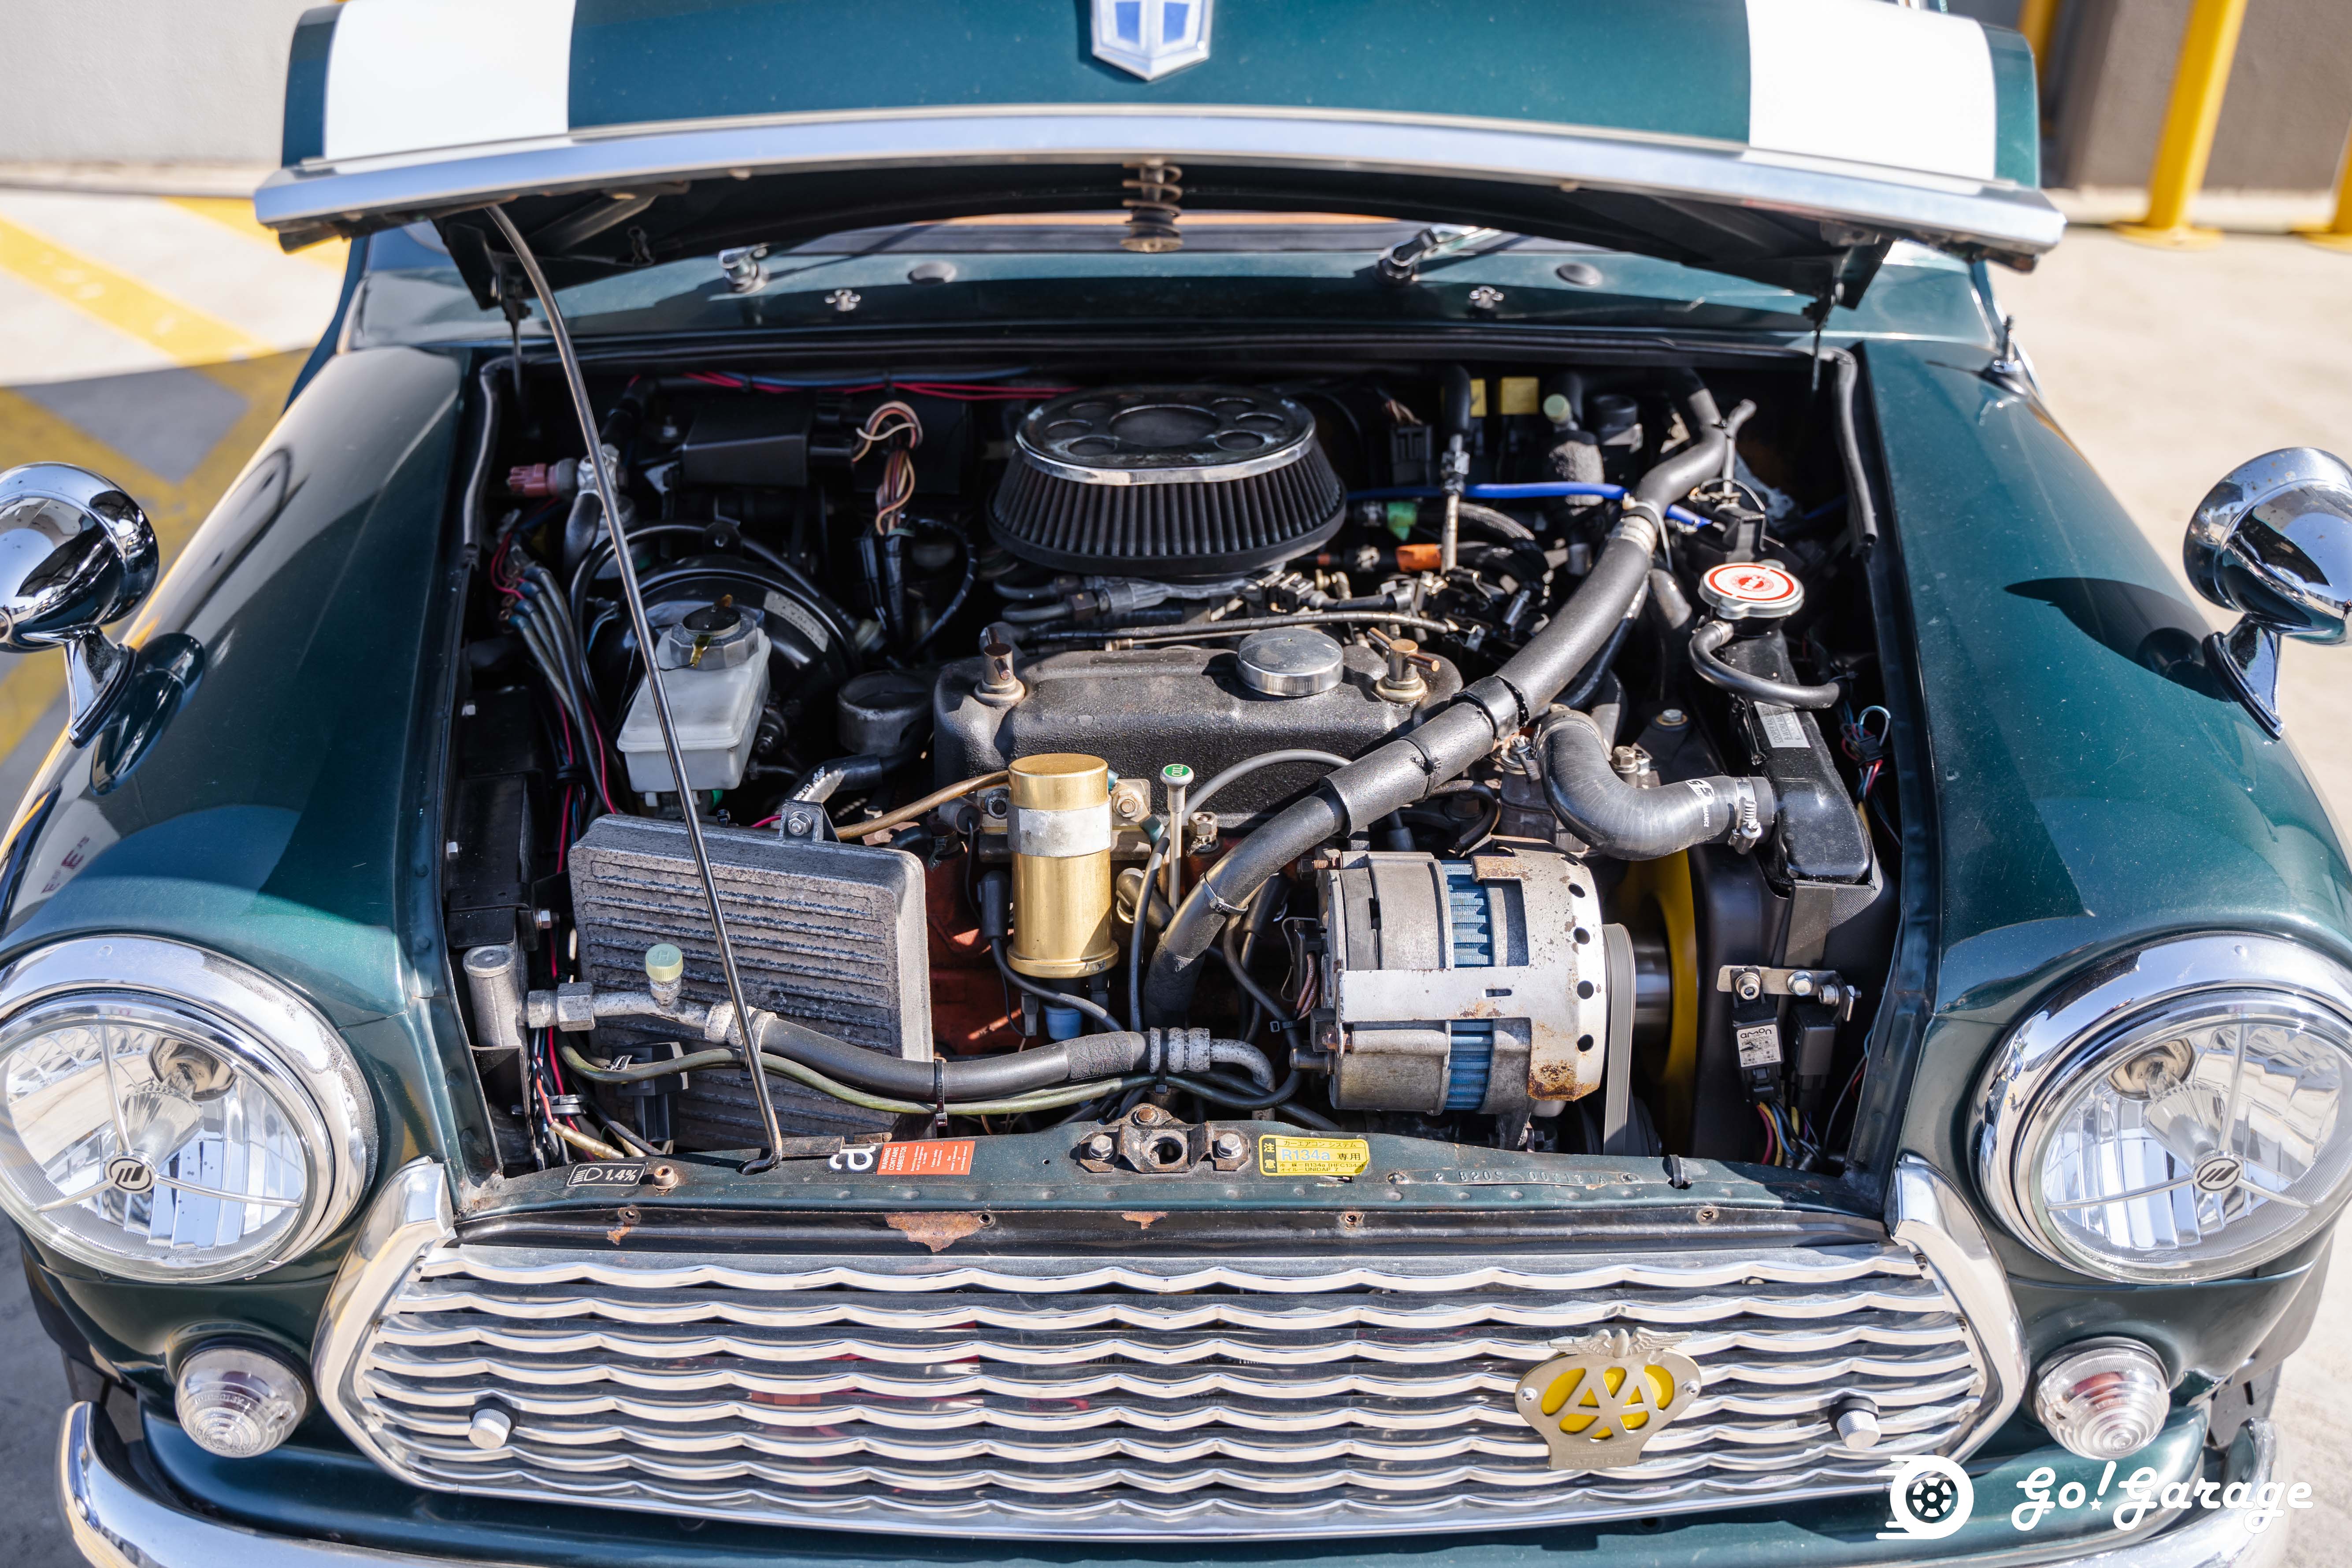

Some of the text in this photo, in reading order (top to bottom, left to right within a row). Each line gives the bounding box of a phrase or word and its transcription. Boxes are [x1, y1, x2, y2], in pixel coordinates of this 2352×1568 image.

[1172, 766, 1183, 776] OIL
[658, 951, 670, 961] H
[1740, 1028, 1772, 1038] amon
[881, 1148, 891, 1170] WARNING
[888, 1147, 899, 1170] CONTAINS
[896, 1146, 907, 1171] ASBESTOS
[1264, 1143, 1276, 1169] 注意
[1281, 1149, 1330, 1160] R134a
[605, 1169, 638, 1181] 1,4%
